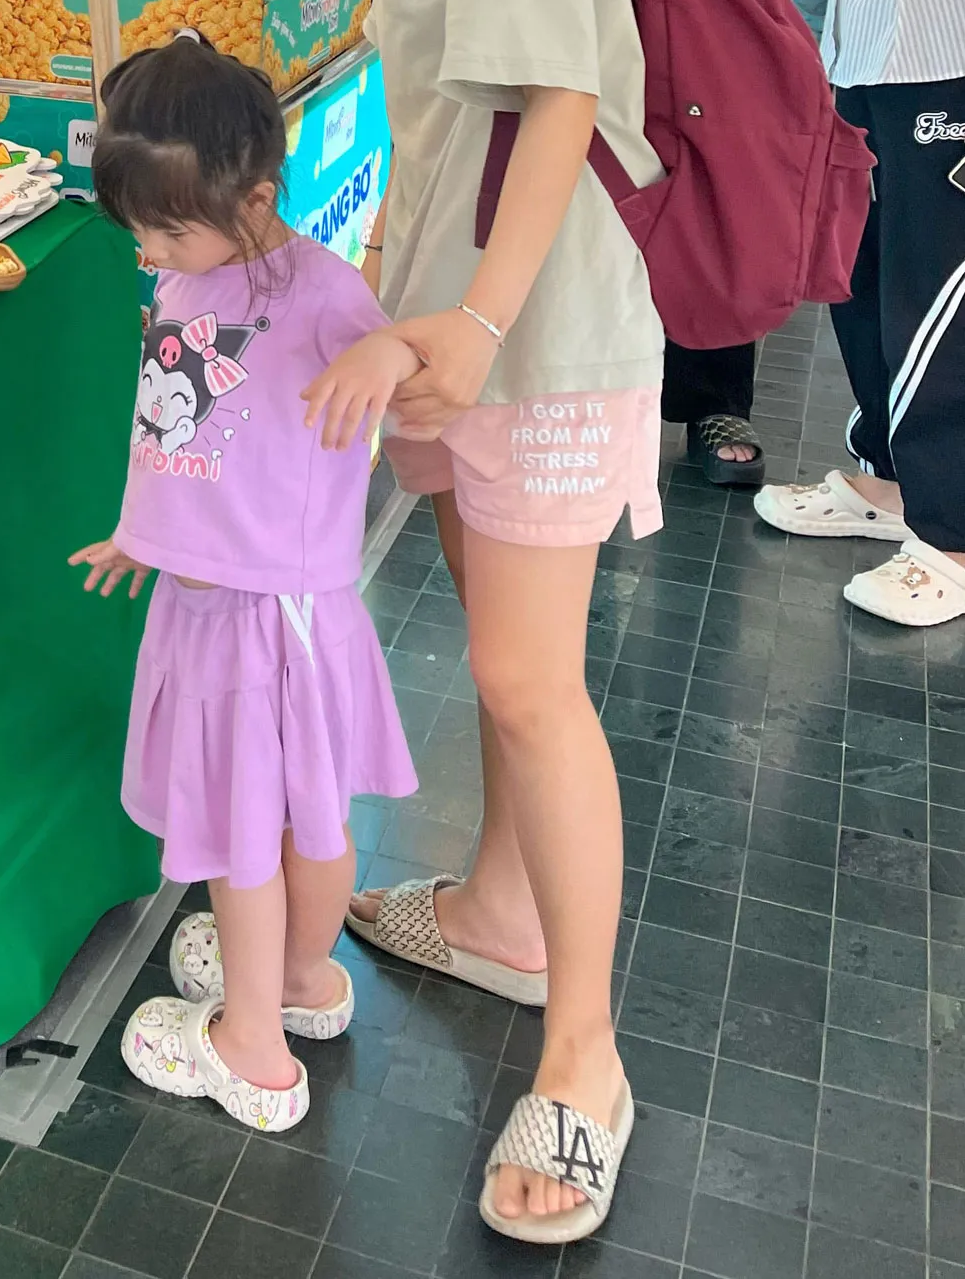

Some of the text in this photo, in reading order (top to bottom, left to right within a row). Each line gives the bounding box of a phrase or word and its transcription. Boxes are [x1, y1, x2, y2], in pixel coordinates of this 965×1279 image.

[532, 403, 578, 420] GOT
[585, 402, 606, 419] IT
[511, 425, 612, 445] FROM MY
[551, 1100, 605, 1193] LA
